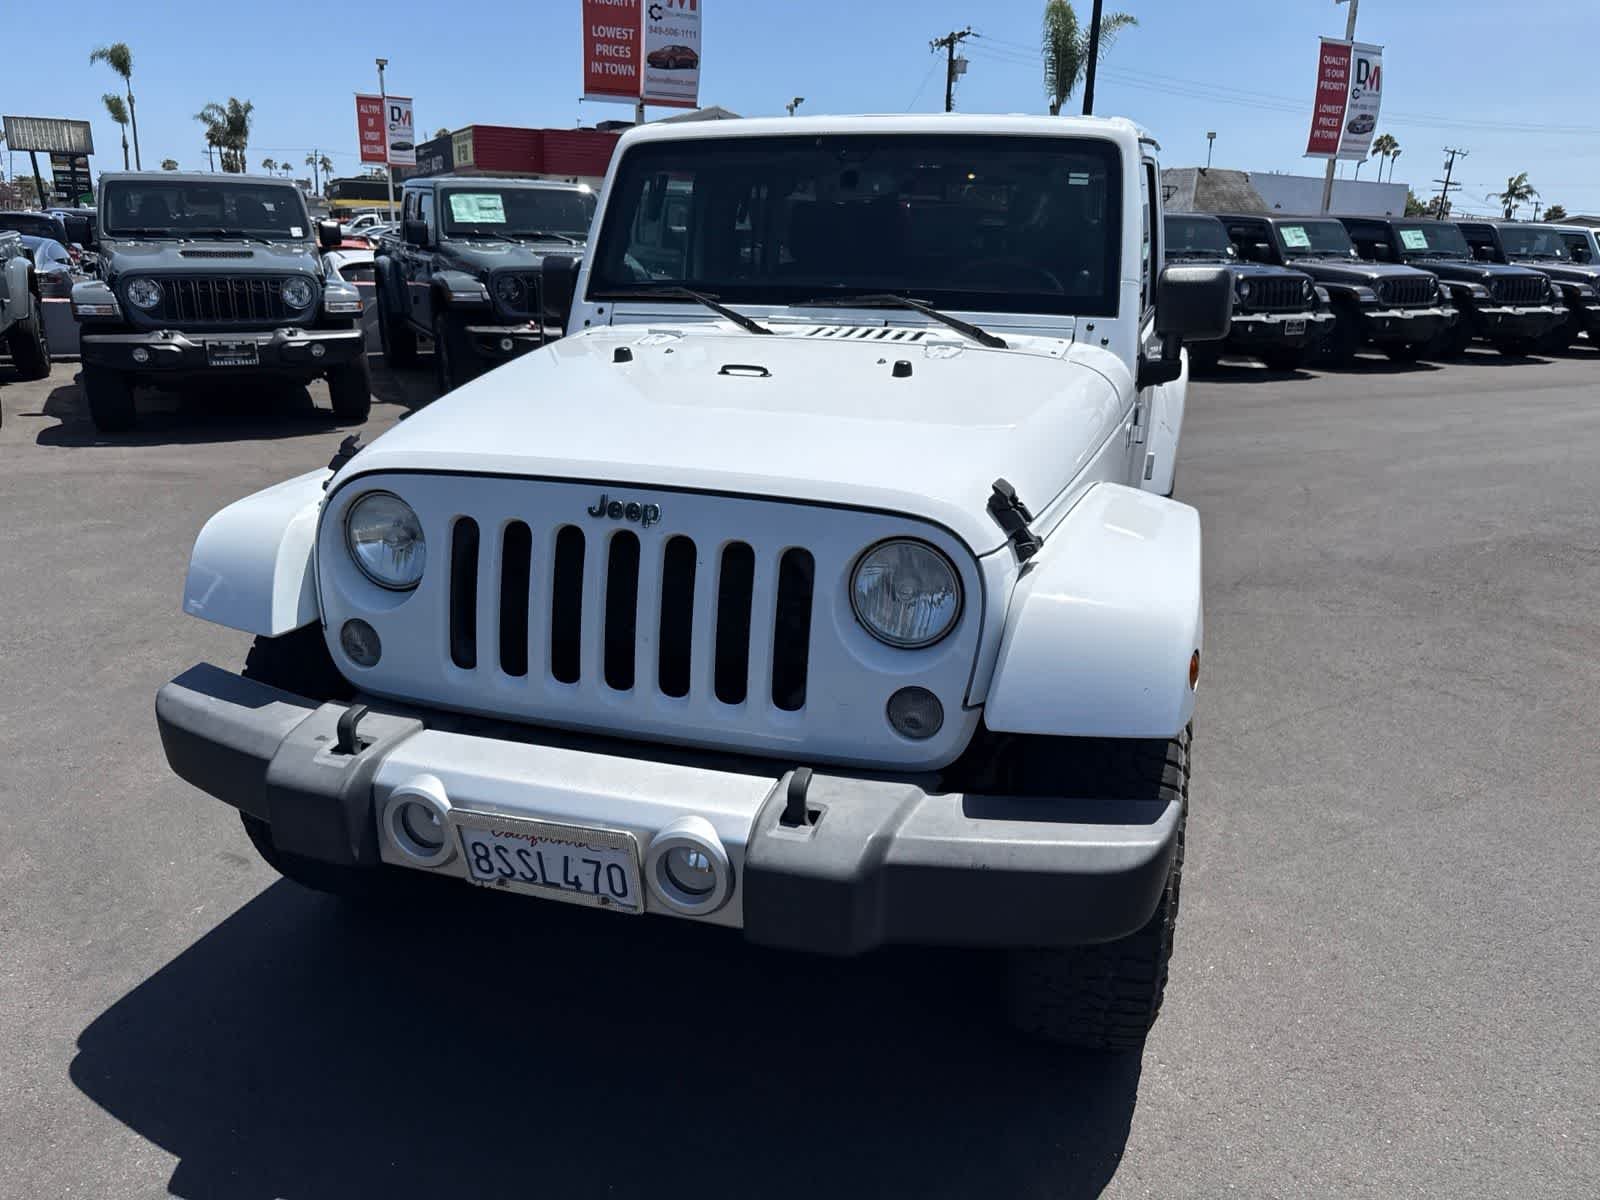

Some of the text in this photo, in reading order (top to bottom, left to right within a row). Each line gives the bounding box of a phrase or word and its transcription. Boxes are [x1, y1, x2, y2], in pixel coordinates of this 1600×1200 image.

[592, 25, 635, 40] LOWEST
[595, 44, 631, 58] PRICES
[591, 61, 636, 77] IN TOWN
[588, 494, 661, 528] Jeep
